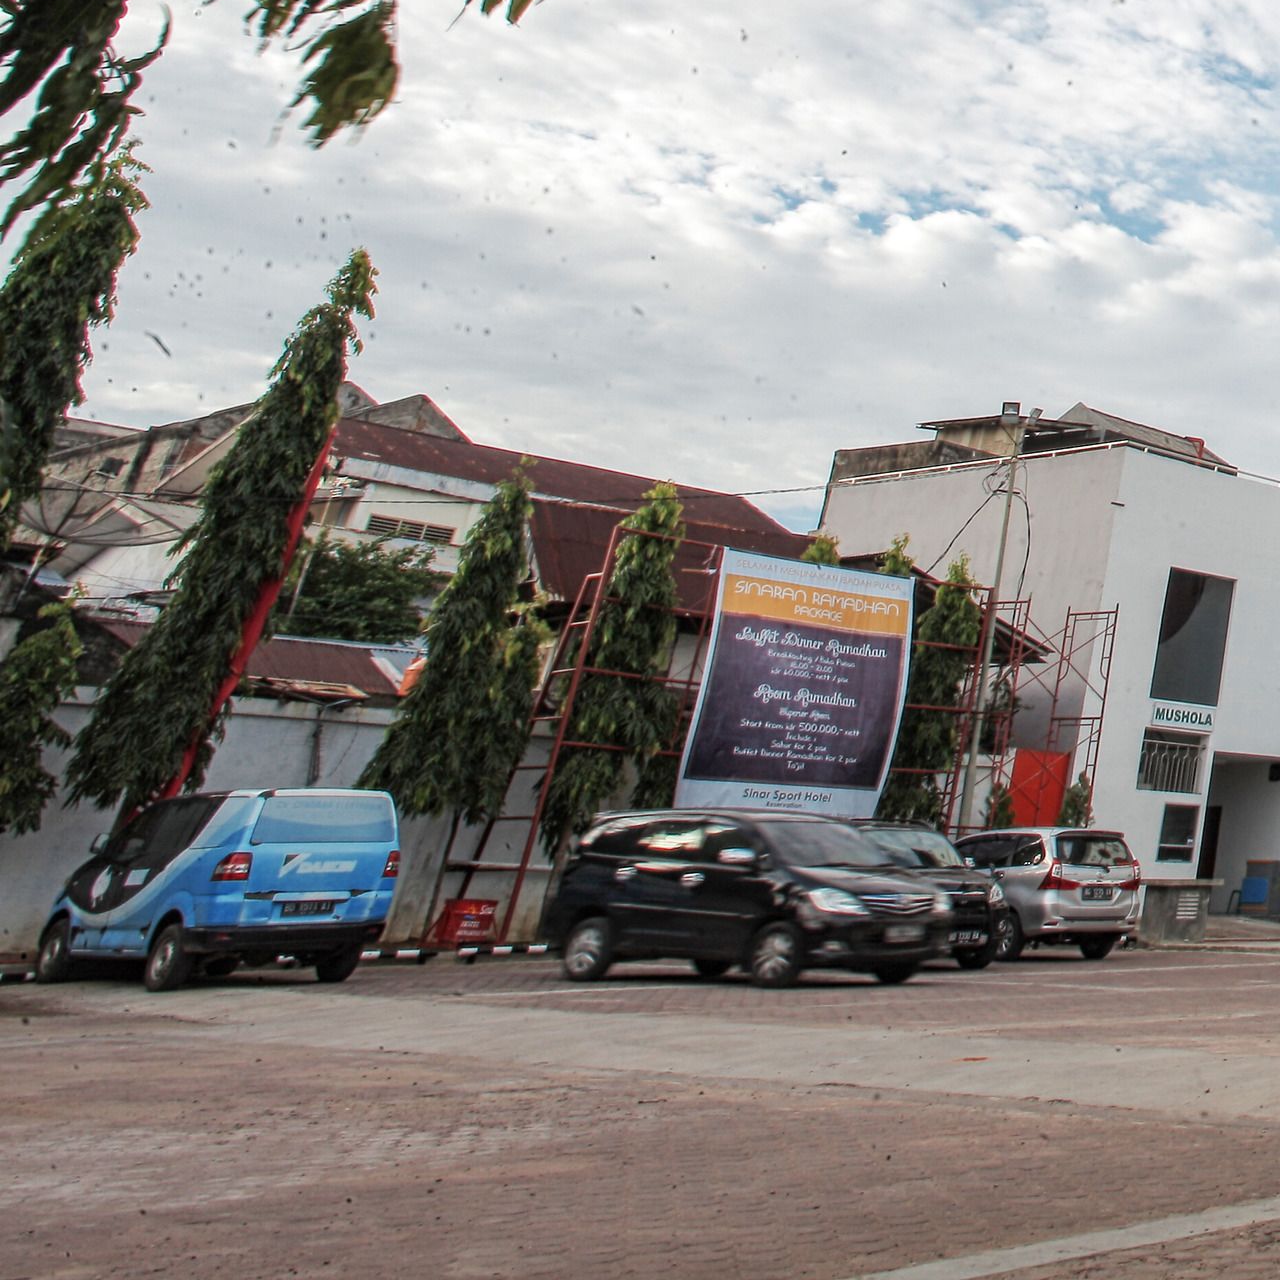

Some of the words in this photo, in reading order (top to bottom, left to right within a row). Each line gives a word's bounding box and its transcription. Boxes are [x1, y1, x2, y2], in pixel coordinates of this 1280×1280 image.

[737, 559, 777, 574] SELAMAT
[874, 581, 902, 592] PUASA
[735, 580, 807, 602] SINARAN
[812, 592, 899, 617] RAMADHAN
[794, 605, 843, 622] PACKAGE
[736, 626, 779, 647] Buffet
[781, 631, 824, 650] Dinner
[825, 639, 887, 658] Ramadhan
[754, 683, 792, 704] Room
[794, 687, 857, 708] Ramadhan
[740, 718, 762, 728] Start
[1155, 707, 1213, 726] MUSHOLA
[733, 746, 759, 756] Buffet
[760, 748, 785, 758] Dinner
[743, 788, 772, 800] Sinar
[773, 790, 802, 802] Sport
[804, 791, 833, 803] Hotel
